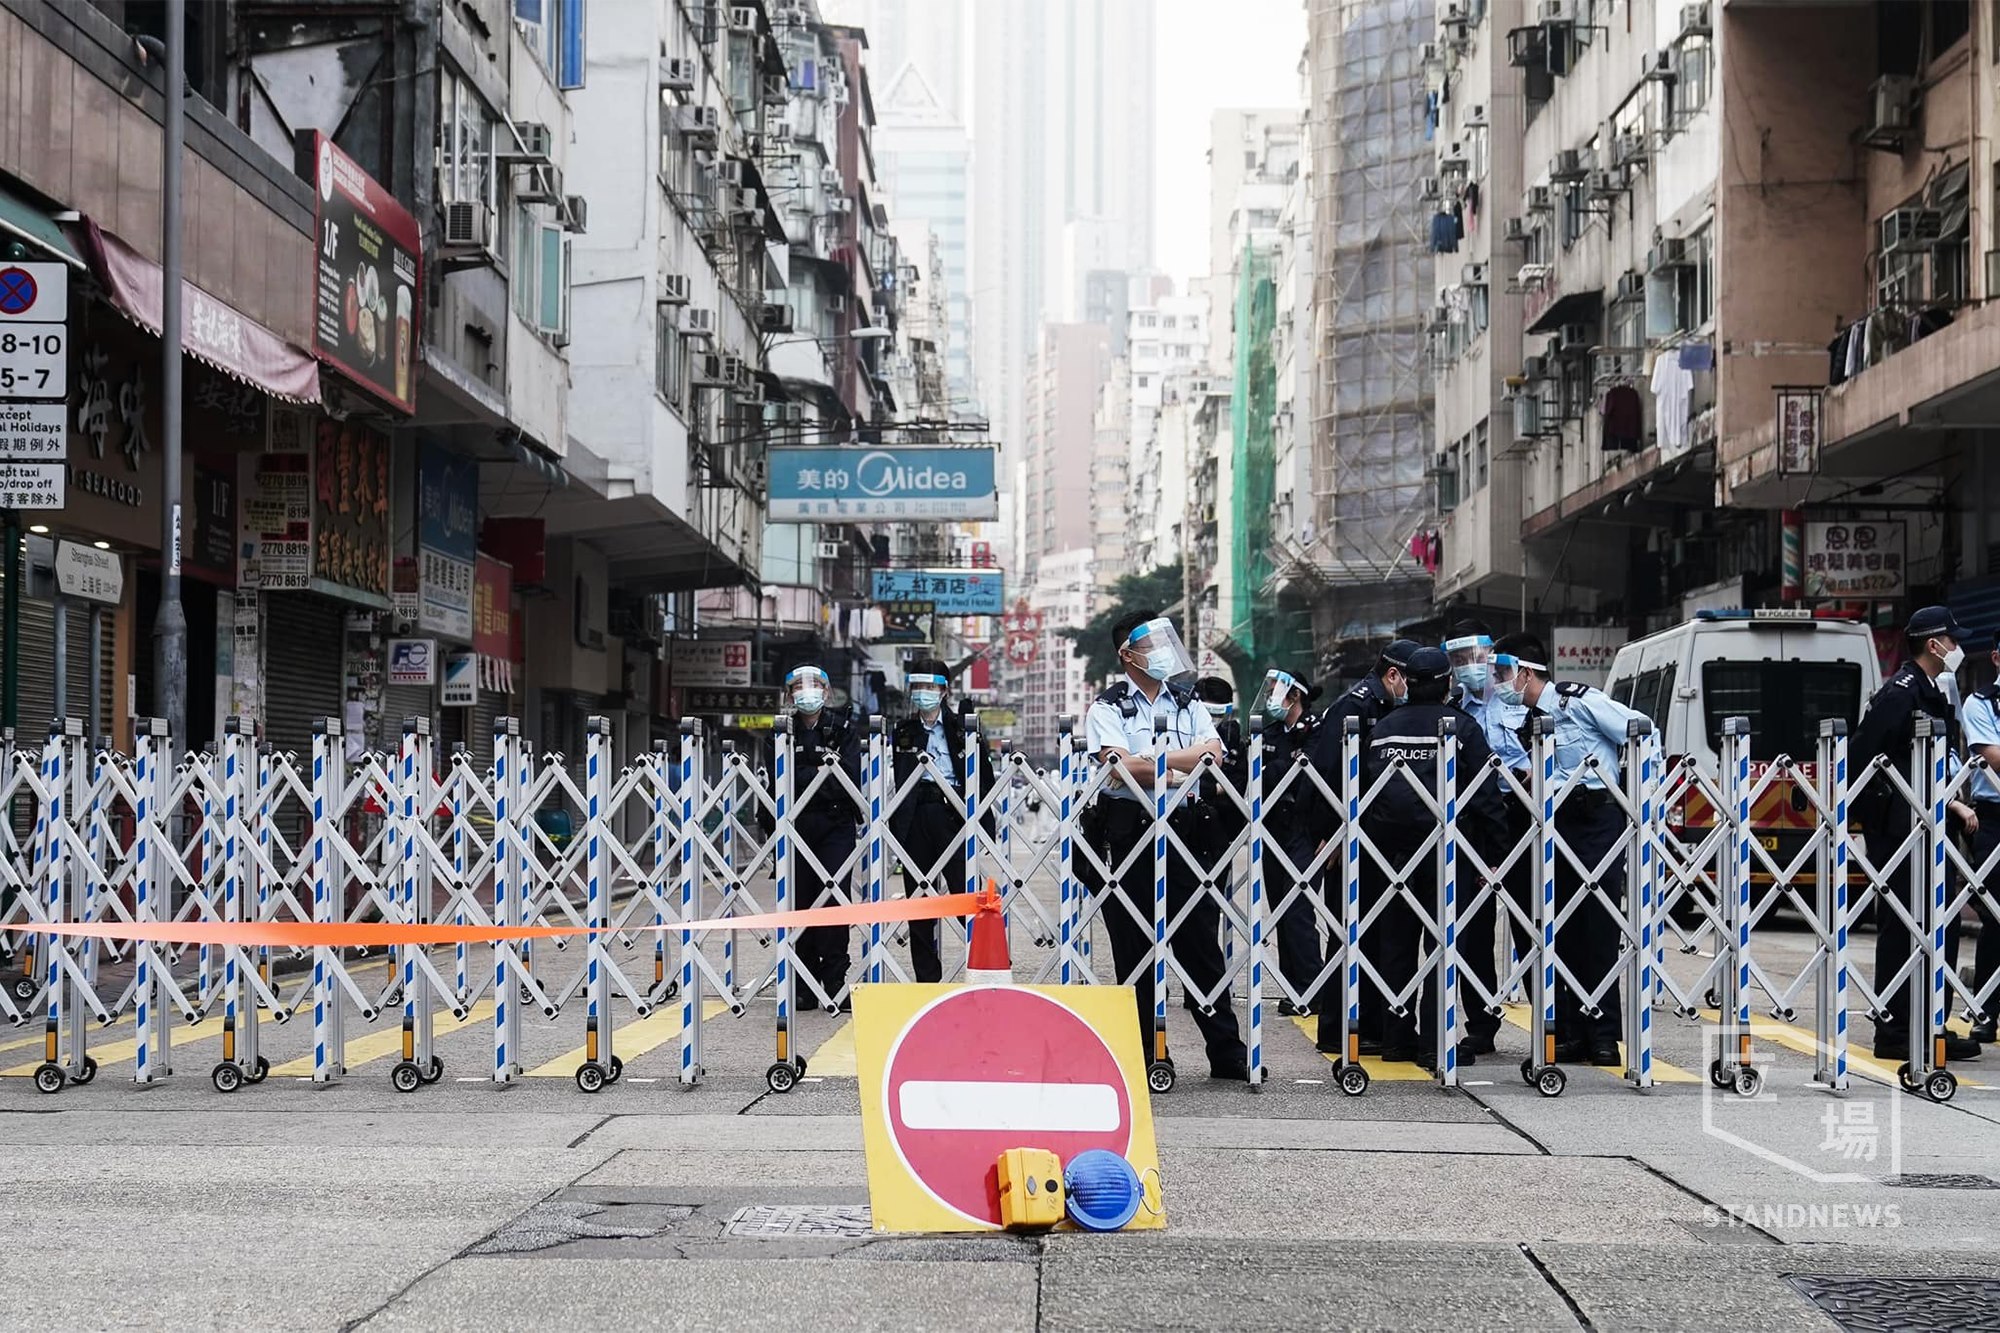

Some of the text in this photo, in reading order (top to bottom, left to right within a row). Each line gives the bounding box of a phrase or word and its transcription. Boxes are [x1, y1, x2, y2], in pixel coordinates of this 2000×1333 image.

[323, 218, 338, 260] 1/F
[1, 333, 62, 355] 8-10
[10, 423, 61, 433] Holidays
[20, 468, 40, 477] taxi
[797, 466, 967, 490] 美的 Midea
[37, 479, 52, 488] off
[85, 470, 143, 507] SEAFOOD
[261, 543, 308, 555] 2770 8819
[260, 575, 308, 588] 2770 8819
